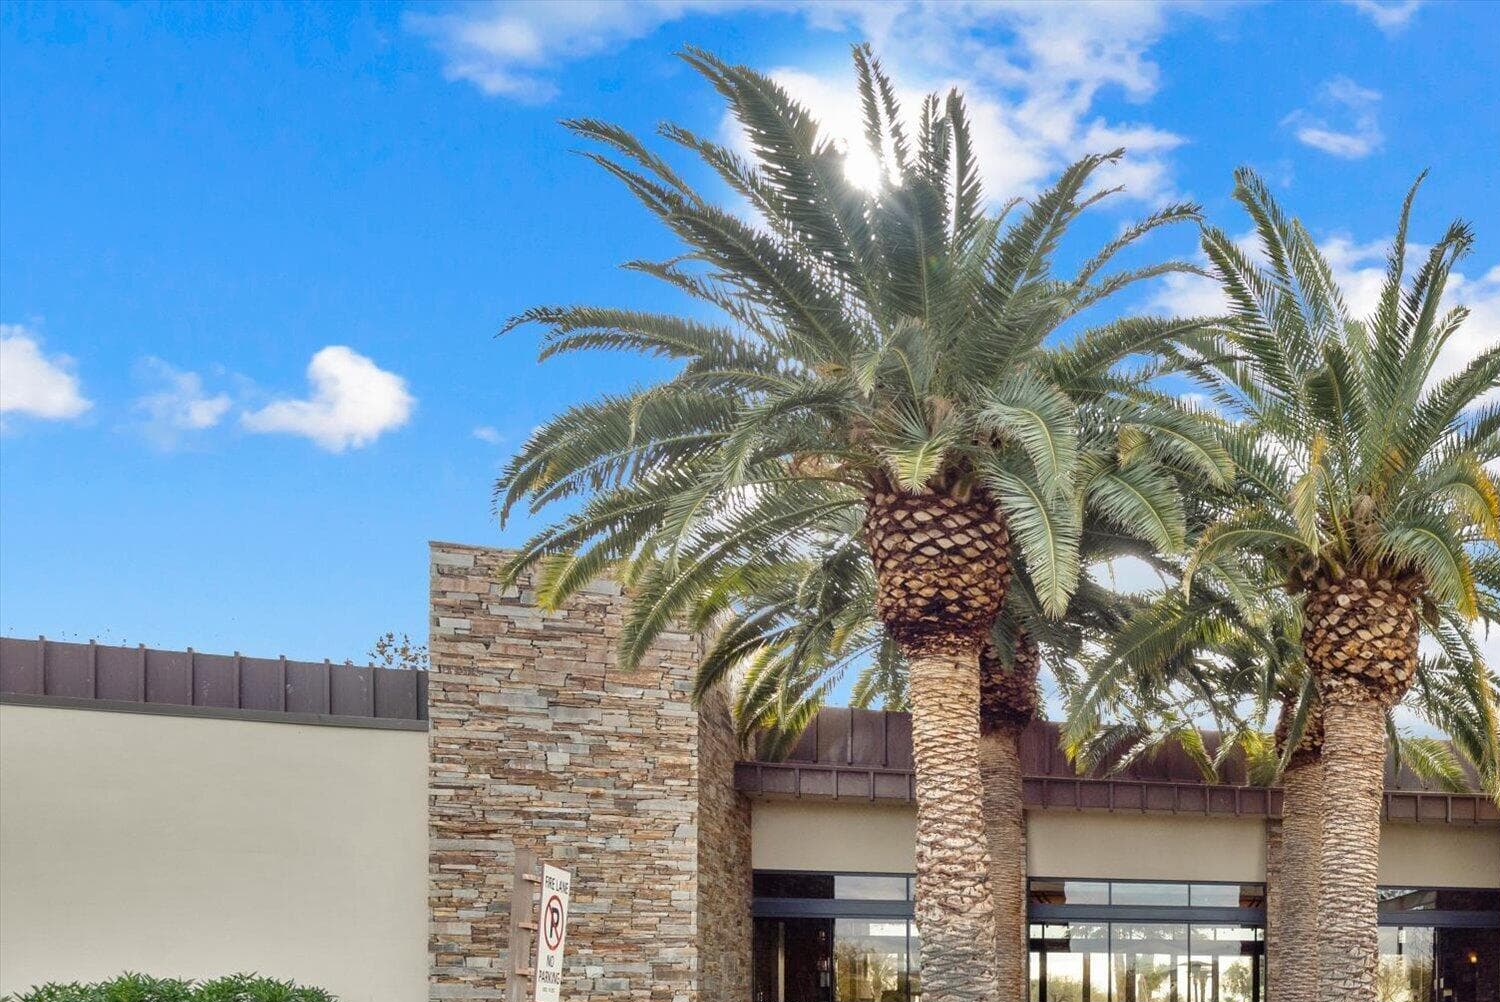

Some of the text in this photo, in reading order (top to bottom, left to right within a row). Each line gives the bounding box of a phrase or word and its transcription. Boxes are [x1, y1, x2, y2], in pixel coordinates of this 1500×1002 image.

[545, 875, 568, 894] FIRE LANE
[546, 954, 554, 968] NO
[538, 969, 560, 985] PARKING
